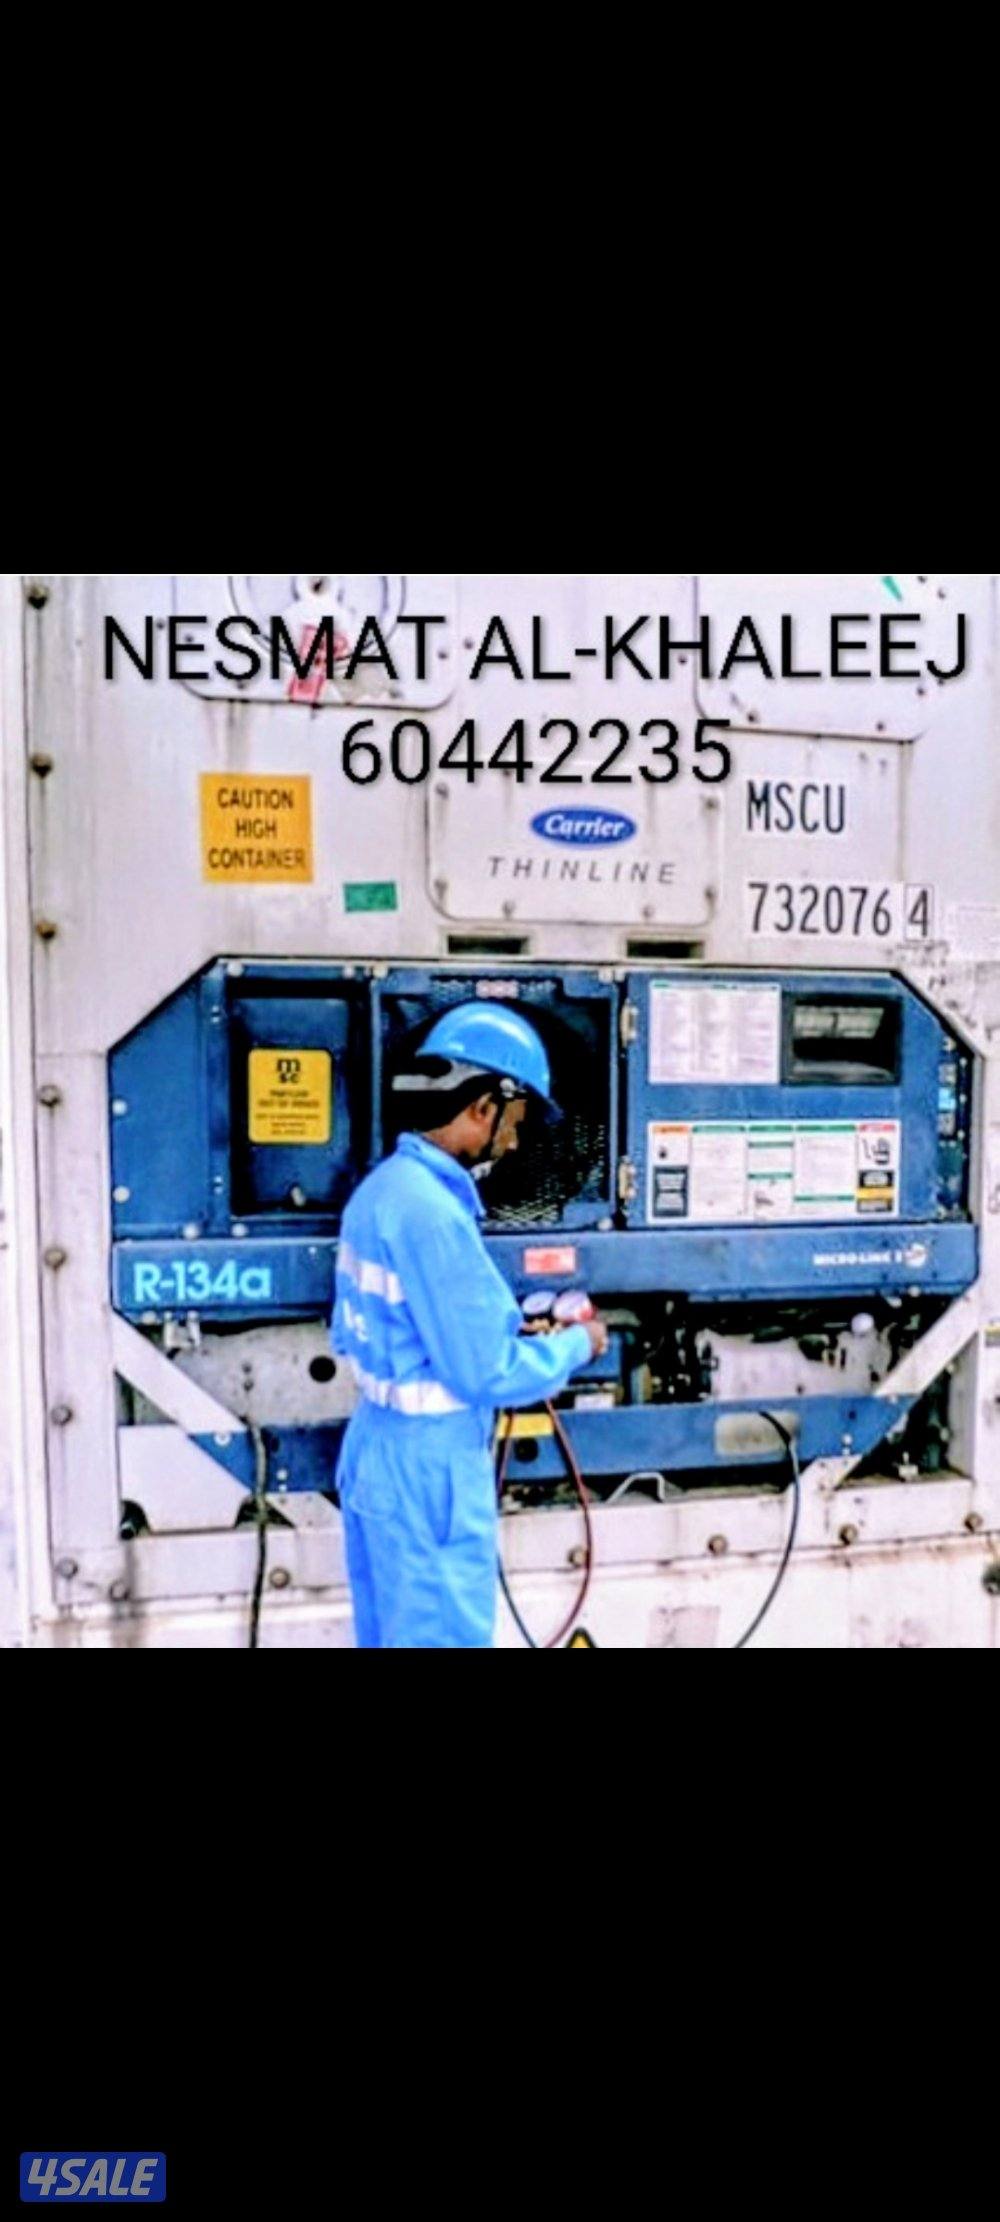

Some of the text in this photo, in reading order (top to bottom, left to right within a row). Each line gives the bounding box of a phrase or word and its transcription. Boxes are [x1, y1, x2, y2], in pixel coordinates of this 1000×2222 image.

[216, 787, 295, 810] CAUTION
[745, 780, 847, 835] MSCU
[235, 818, 279, 840] HIGH
[544, 814, 626, 841] Carrier
[208, 847, 306, 870] CONTAINER
[488, 856, 677, 885] THINLINE
[748, 883, 930, 938] 732076 4
[133, 1259, 272, 1303] R-134a
